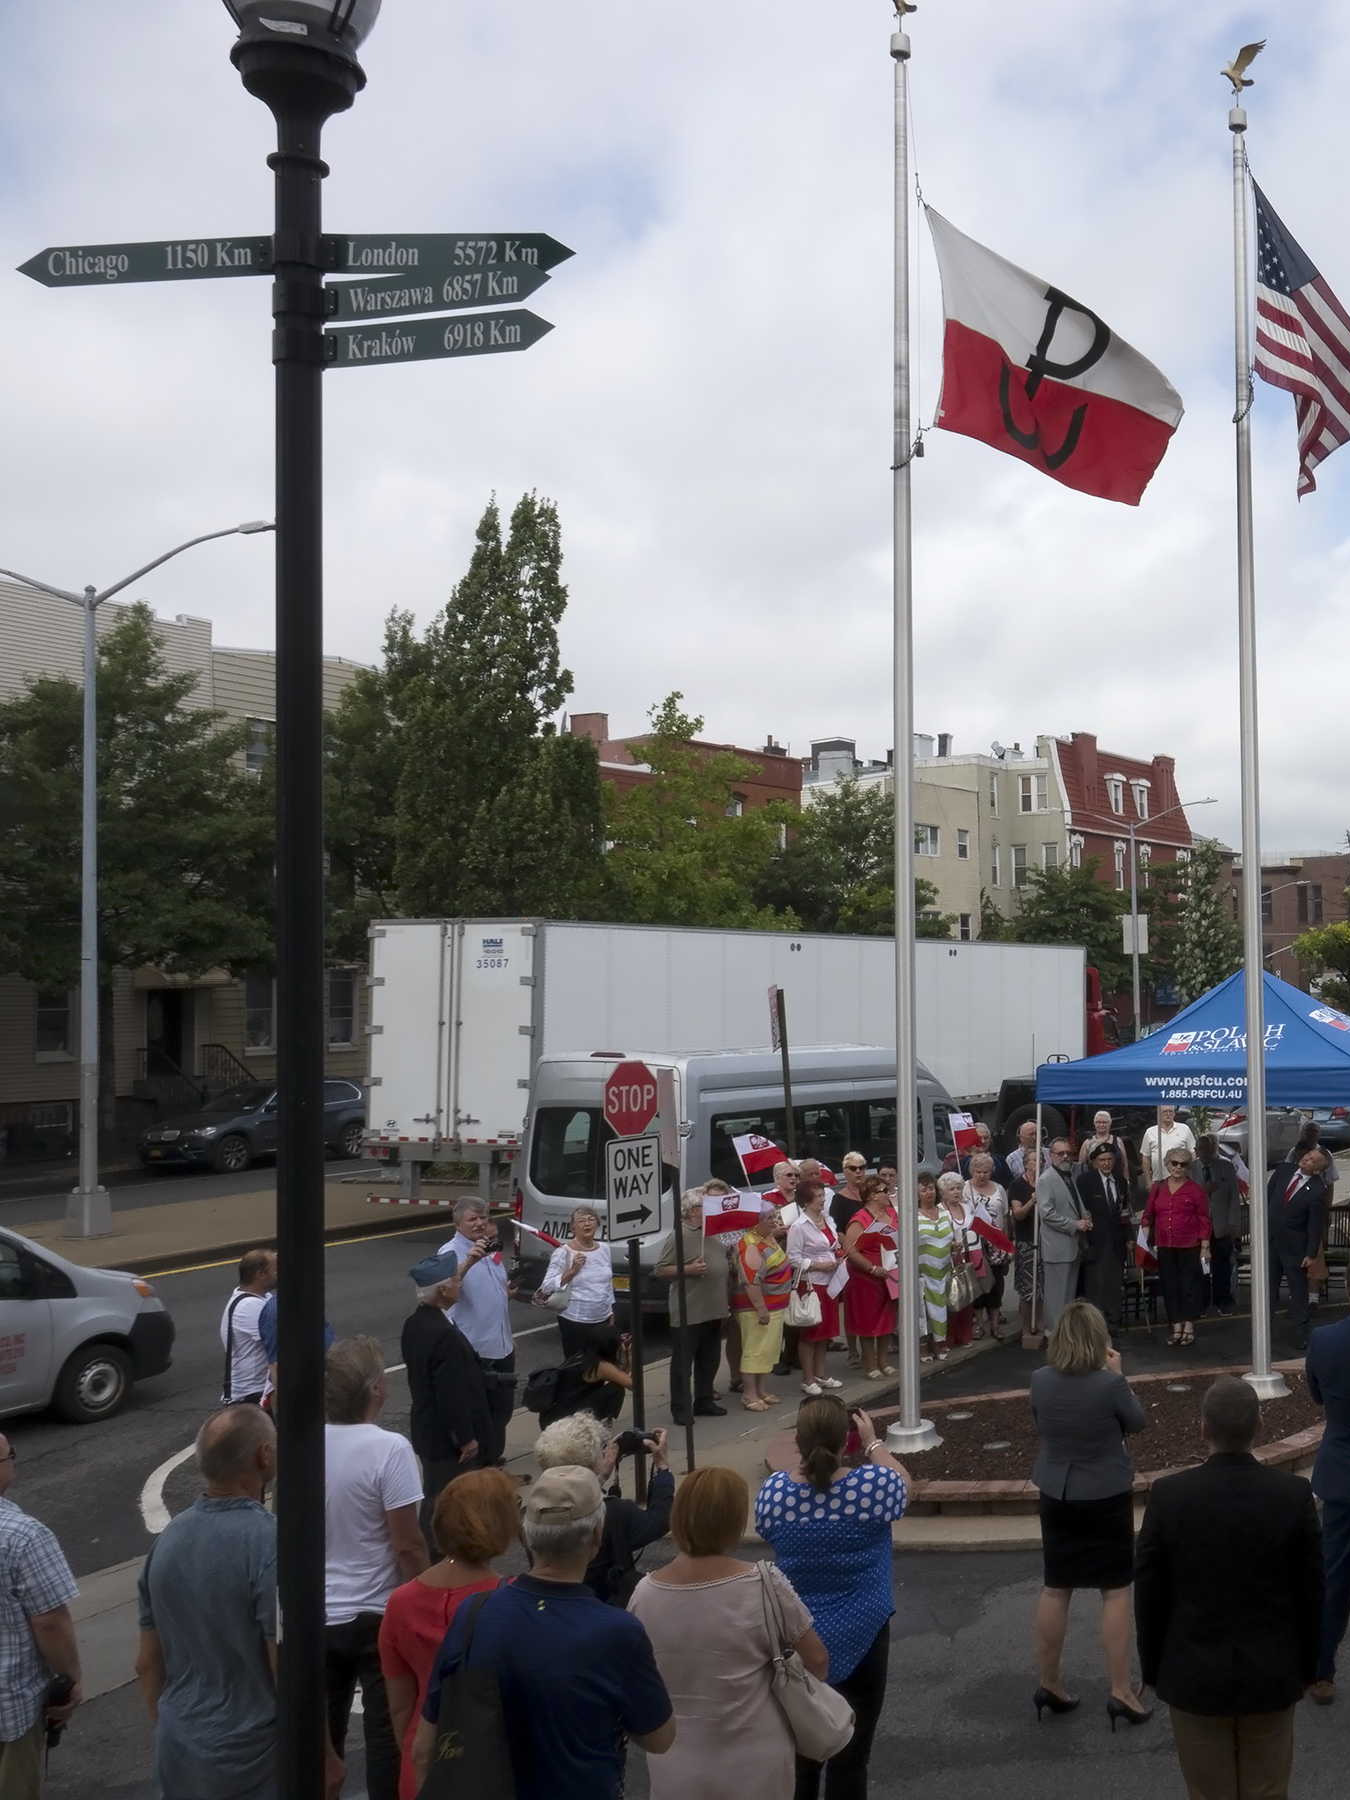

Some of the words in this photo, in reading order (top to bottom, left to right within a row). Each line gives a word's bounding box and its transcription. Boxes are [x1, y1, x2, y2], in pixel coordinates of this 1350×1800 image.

[48, 250, 129, 279] Chicago
[165, 243, 209, 270] 1150
[214, 242, 252, 267] Km
[346, 241, 419, 266] London
[453, 240, 498, 266] 5572
[504, 241, 539, 266] Km
[349, 286, 433, 313] Warszawa
[443, 273, 482, 302] 6857
[487, 271, 518, 297] Km
[347, 329, 416, 360] Kraków
[444, 321, 484, 350] 6918
[489, 319, 521, 346] Km
[476, 958, 509, 969] 35087
[1193, 1023, 1286, 1042] POLH
[608, 1084, 655, 1113] STOP
[1160, 1089, 1242, 1099] 1.855.PSFCU.4U
[613, 1145, 653, 1172] ONE
[613, 1171, 654, 1200] WAY
